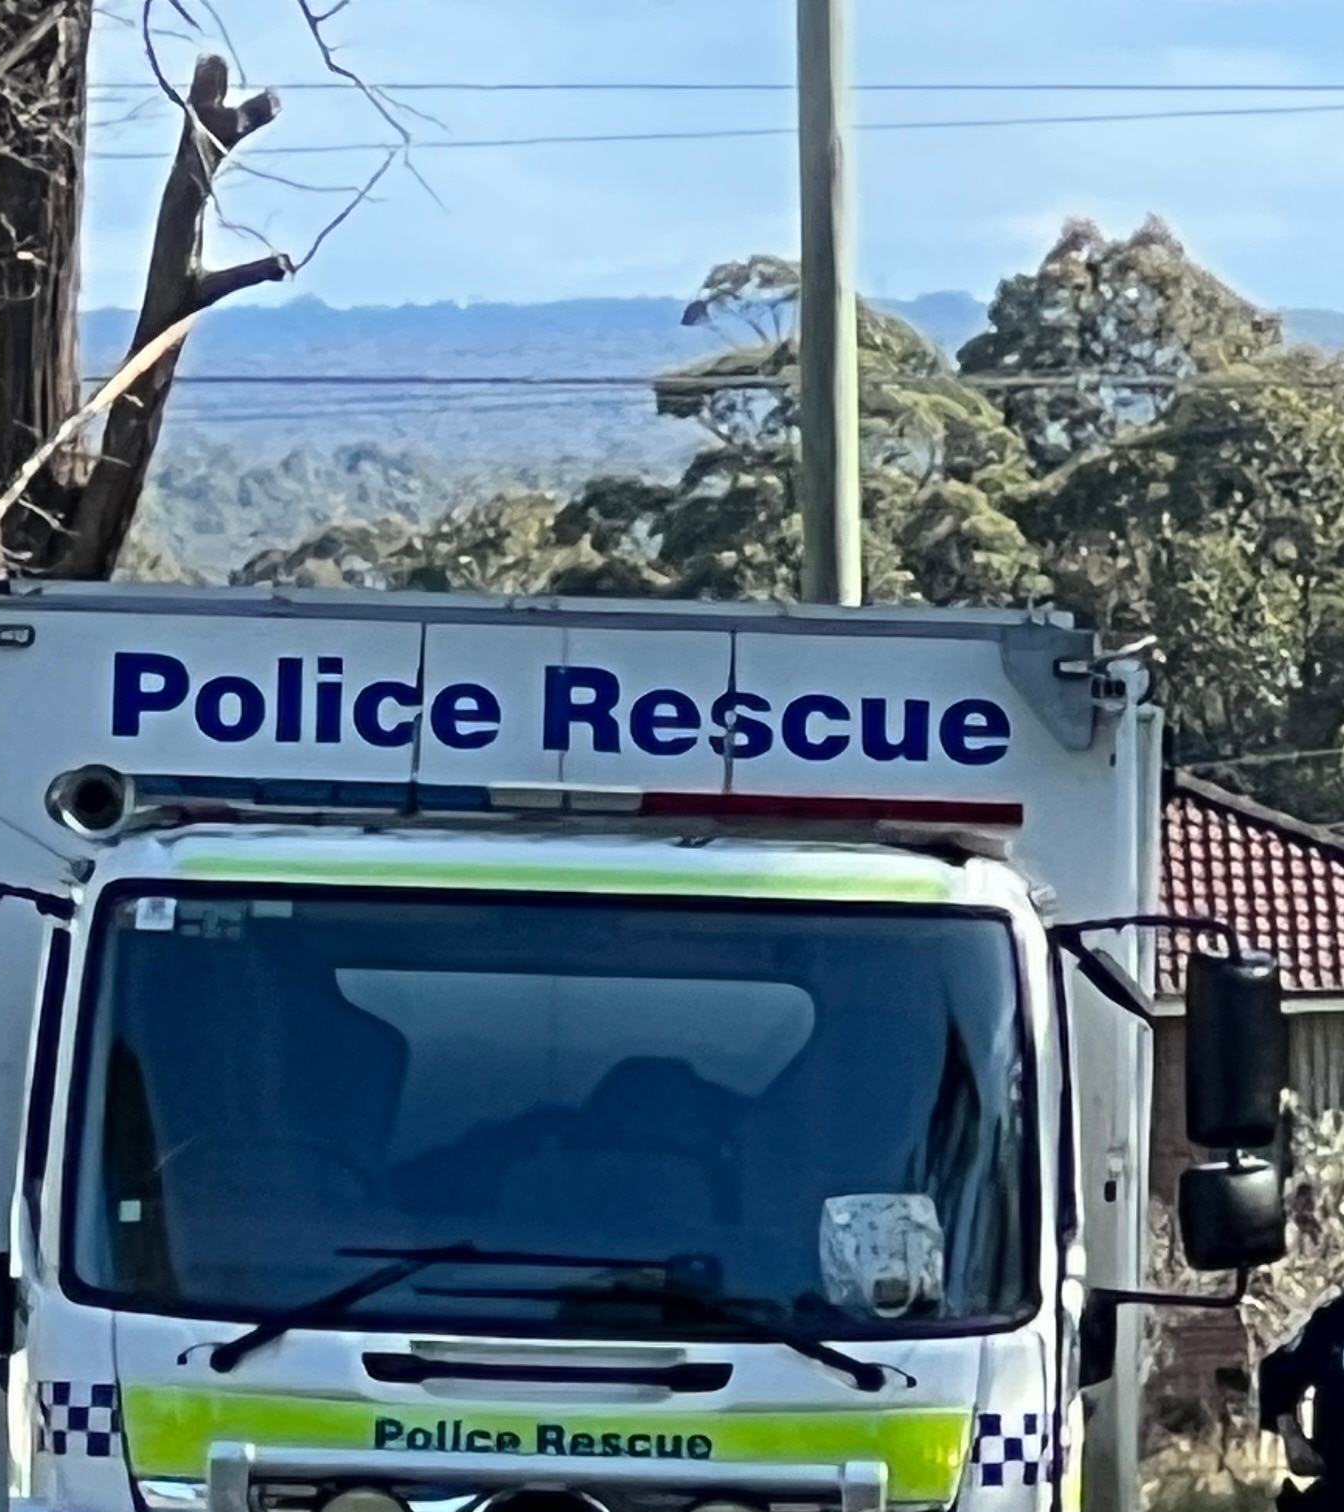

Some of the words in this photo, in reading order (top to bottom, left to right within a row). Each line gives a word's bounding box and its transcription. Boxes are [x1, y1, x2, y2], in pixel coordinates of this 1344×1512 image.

[112, 652, 501, 749] Police
[543, 665, 1011, 766] Rescue
[374, 1416, 521, 1452] Police
[537, 1423, 713, 1460] Rescue
